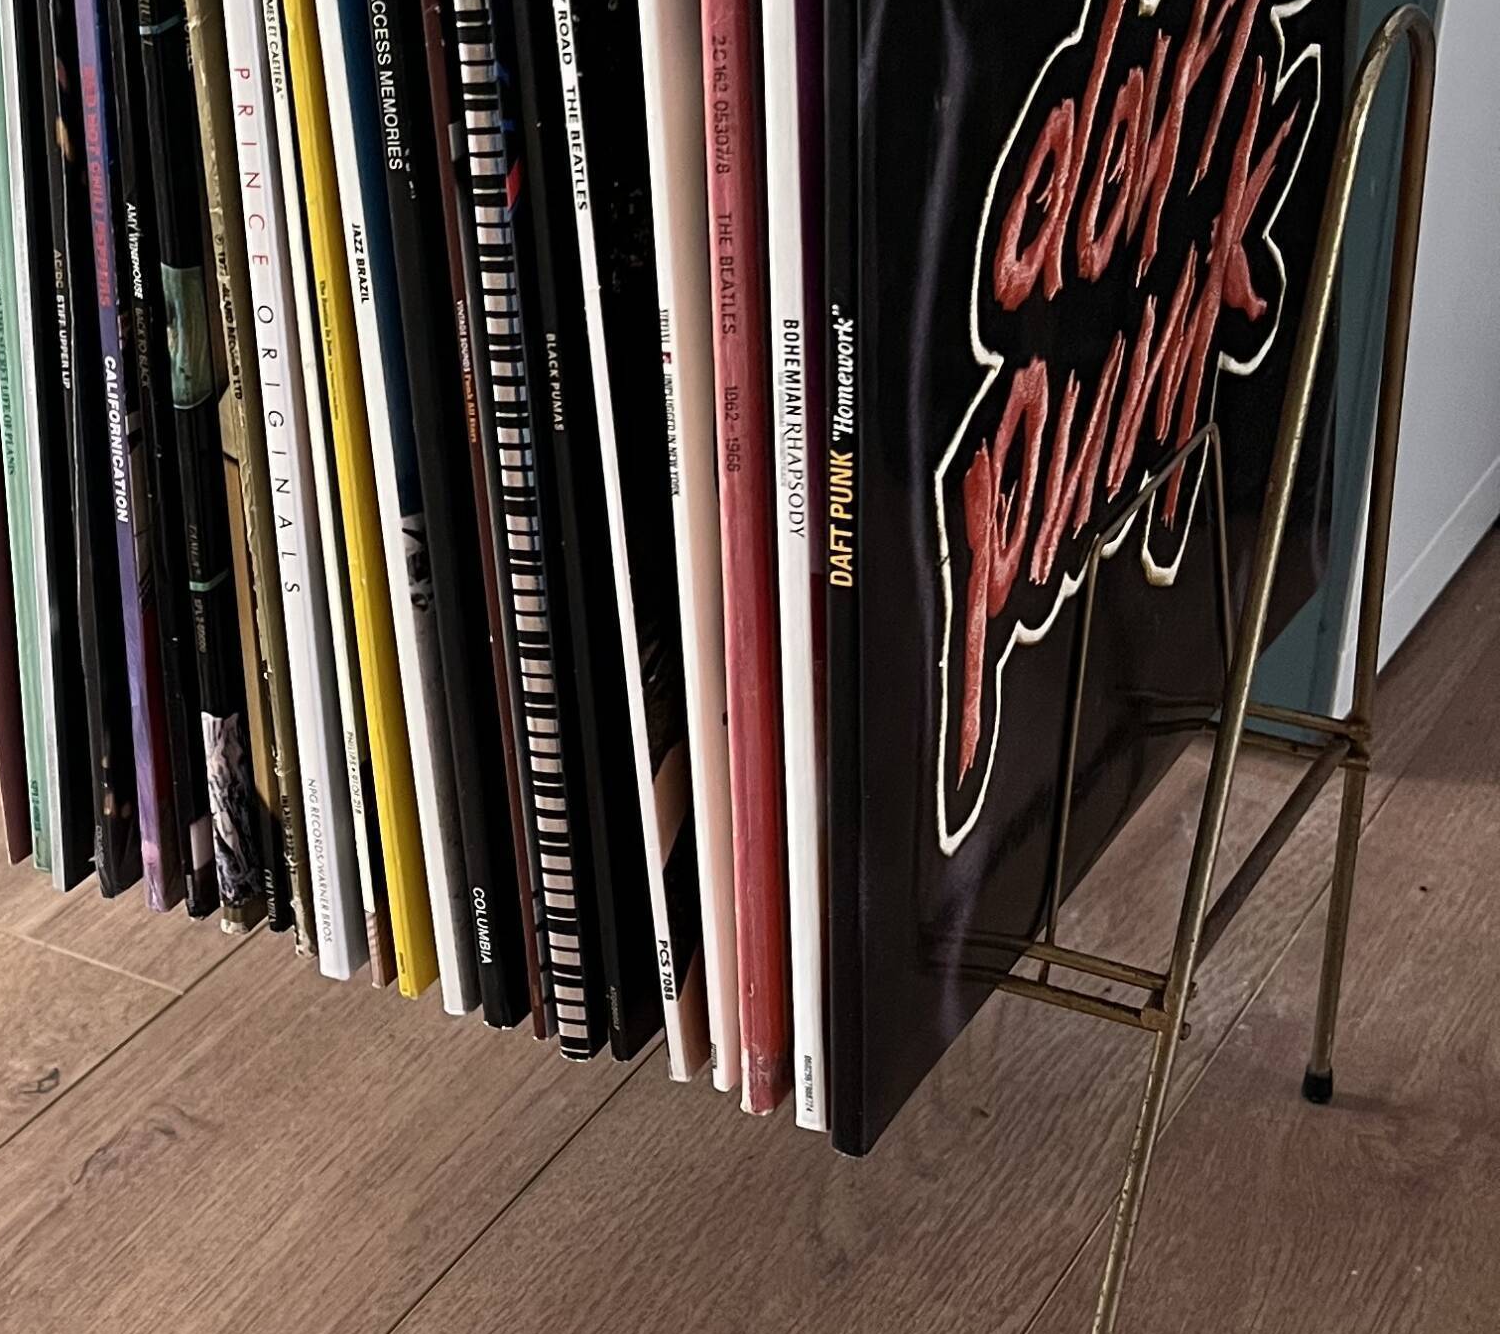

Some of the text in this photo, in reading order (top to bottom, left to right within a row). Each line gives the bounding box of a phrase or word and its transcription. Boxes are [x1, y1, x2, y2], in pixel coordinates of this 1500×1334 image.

[268, 25, 278, 39] ET
[556, 9, 574, 66] ROAD
[379, 70, 403, 171] MEMORIES
[565, 84, 581, 125] THE
[235, 68, 268, 267] PRINCE
[570, 129, 588, 212] BEATLES
[126, 202, 139, 230] AMY
[717, 211, 733, 246] THE
[352, 223, 370, 304] JAZZ BRAZIL
[56, 295, 71, 389] STIFF UPPER LIP
[455, 299, 467, 336] VINTAGE
[459, 337, 471, 373] SOUNDS
[545, 332, 565, 431] BLACK PUMAS
[104, 355, 129, 524] CALIFORNICATION
[258, 305, 300, 594] ORIGINALS
[782, 318, 806, 539] BOHEMIAN RHAPSODY
[830, 449, 853, 518] PUNK
[830, 524, 853, 587] DAFT
[307, 778, 319, 804] NPG
[472, 887, 493, 964] COLUMBIA
[658, 939, 676, 1002] PCS 7088
